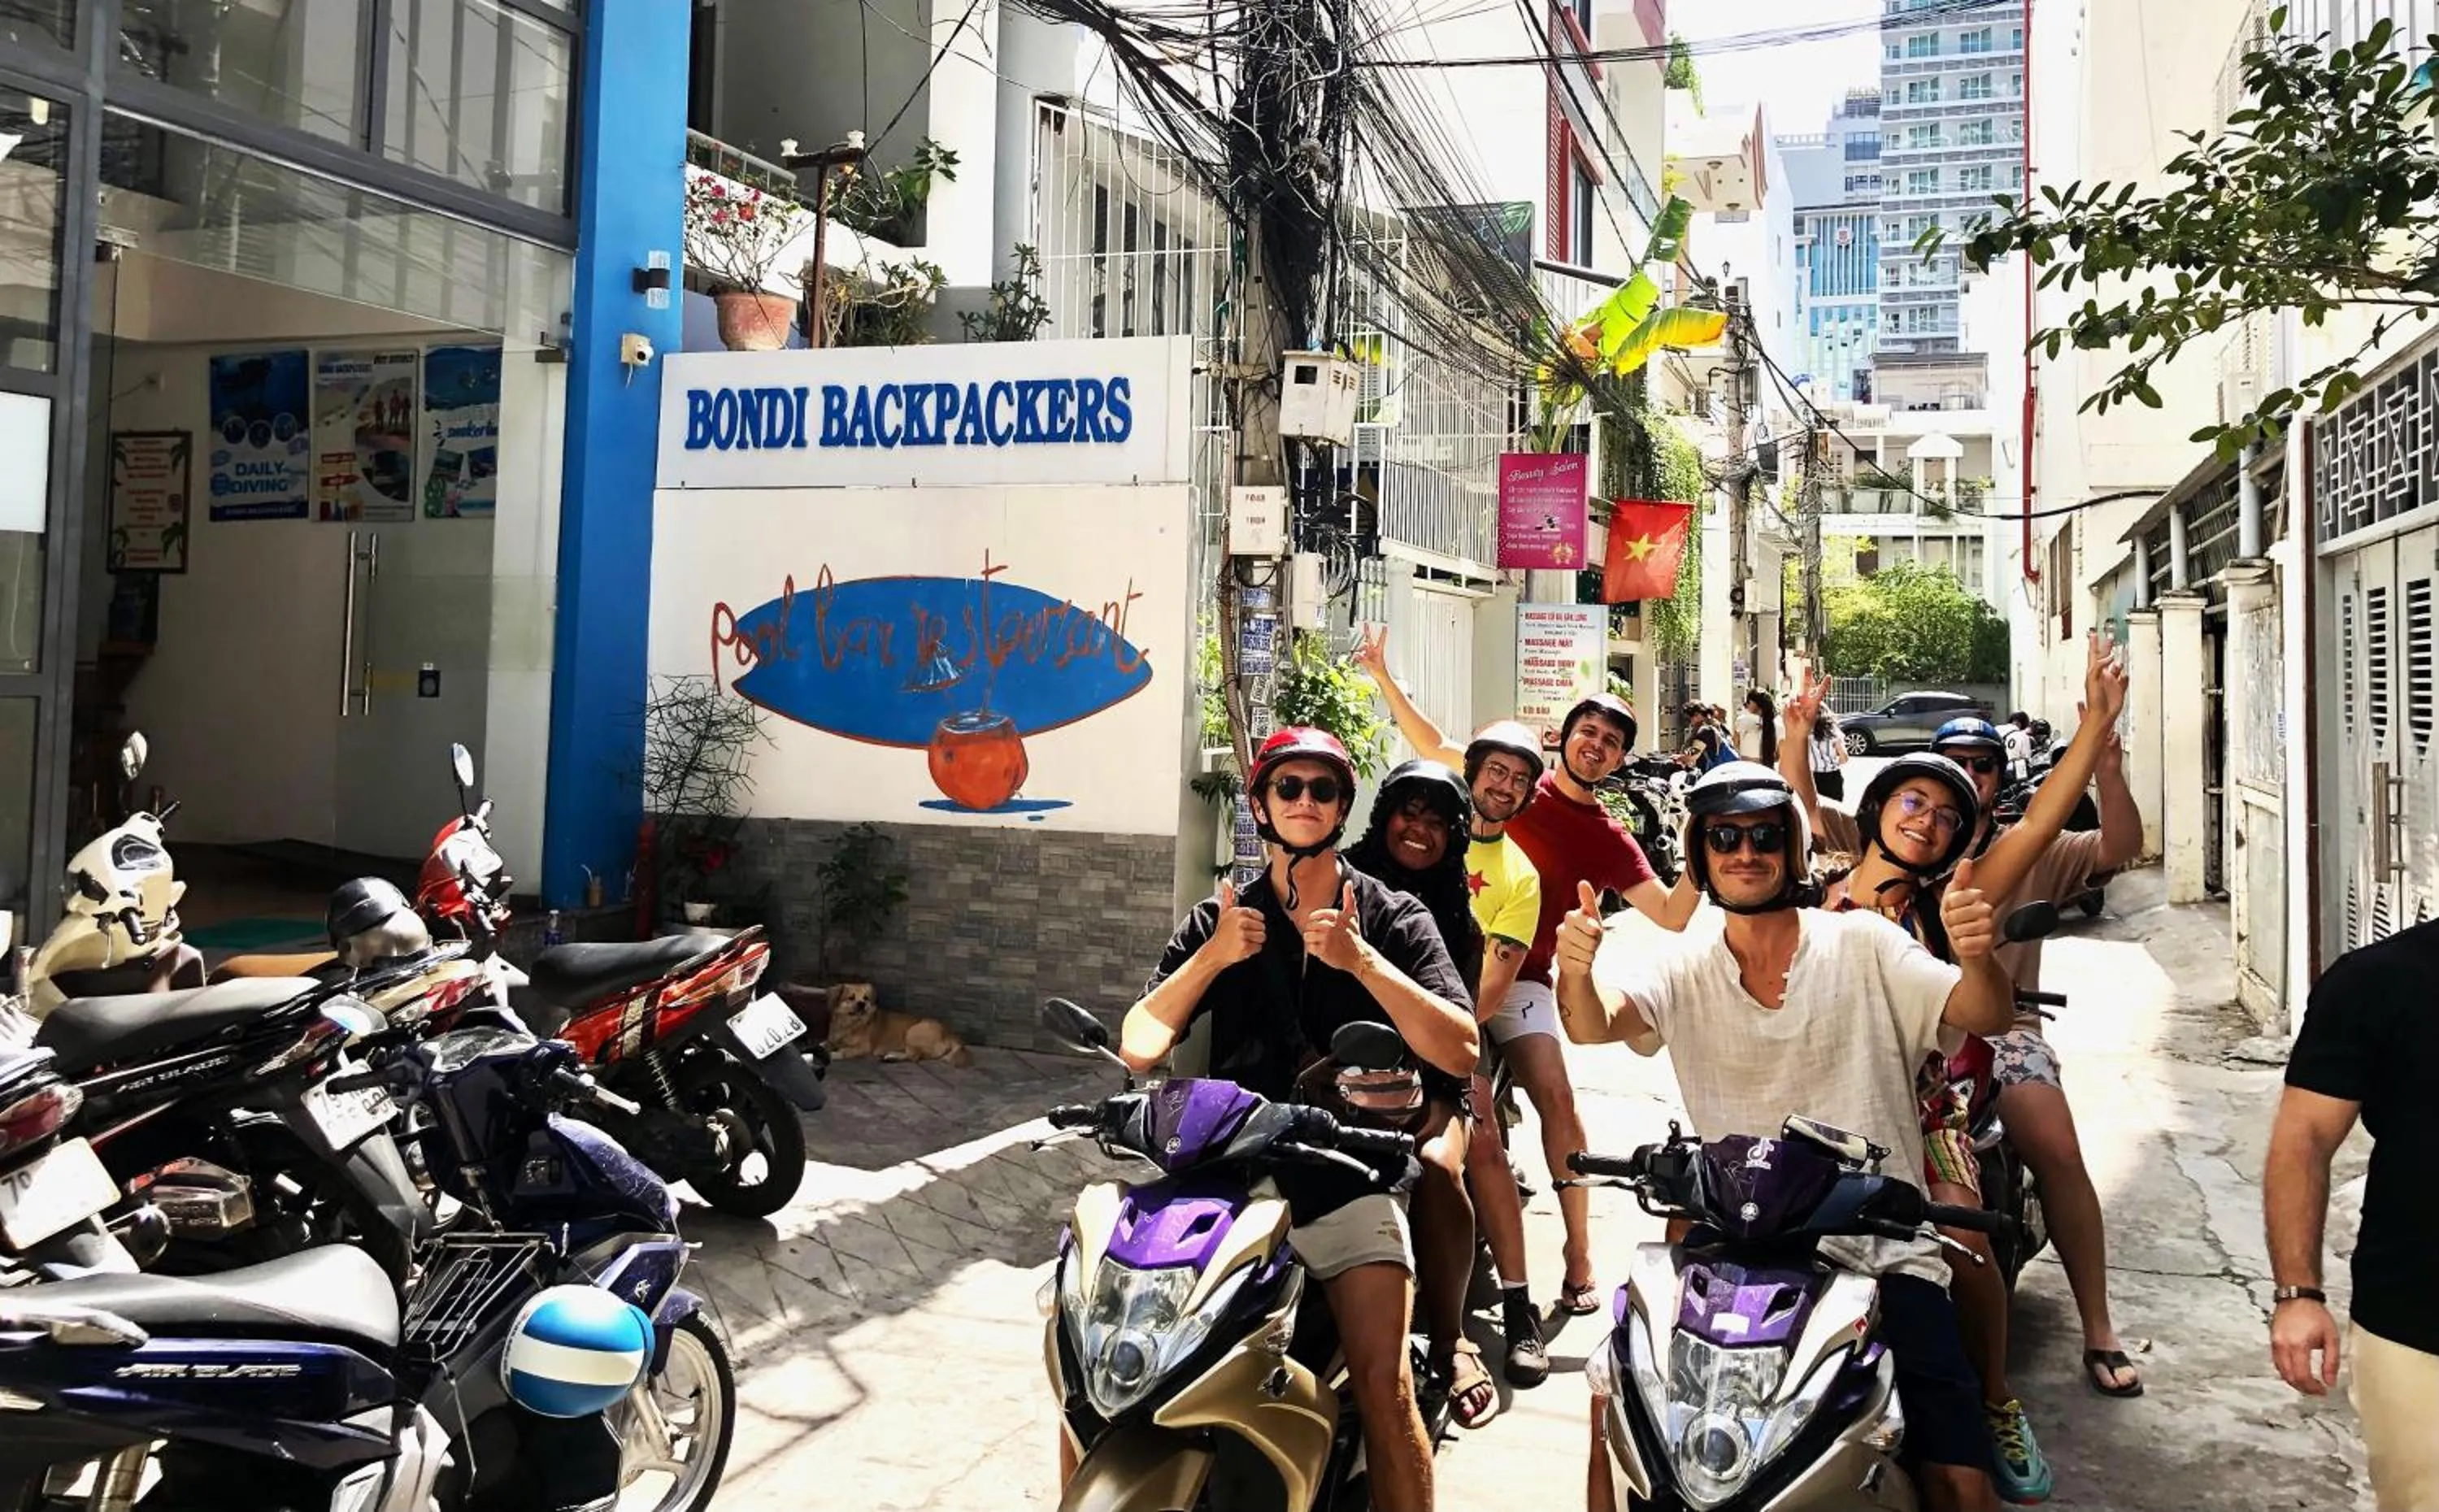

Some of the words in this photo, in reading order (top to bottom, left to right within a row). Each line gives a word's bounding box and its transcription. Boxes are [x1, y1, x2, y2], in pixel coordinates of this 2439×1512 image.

[685, 387, 808, 450] BONDI
[819, 376, 1133, 449] BACKPACKERS
[236, 461, 285, 476] DAILY
[231, 479, 288, 493] DIVING
[1524, 638, 1556, 648] MASSAGE
[191, 1364, 302, 1378] BLADE
